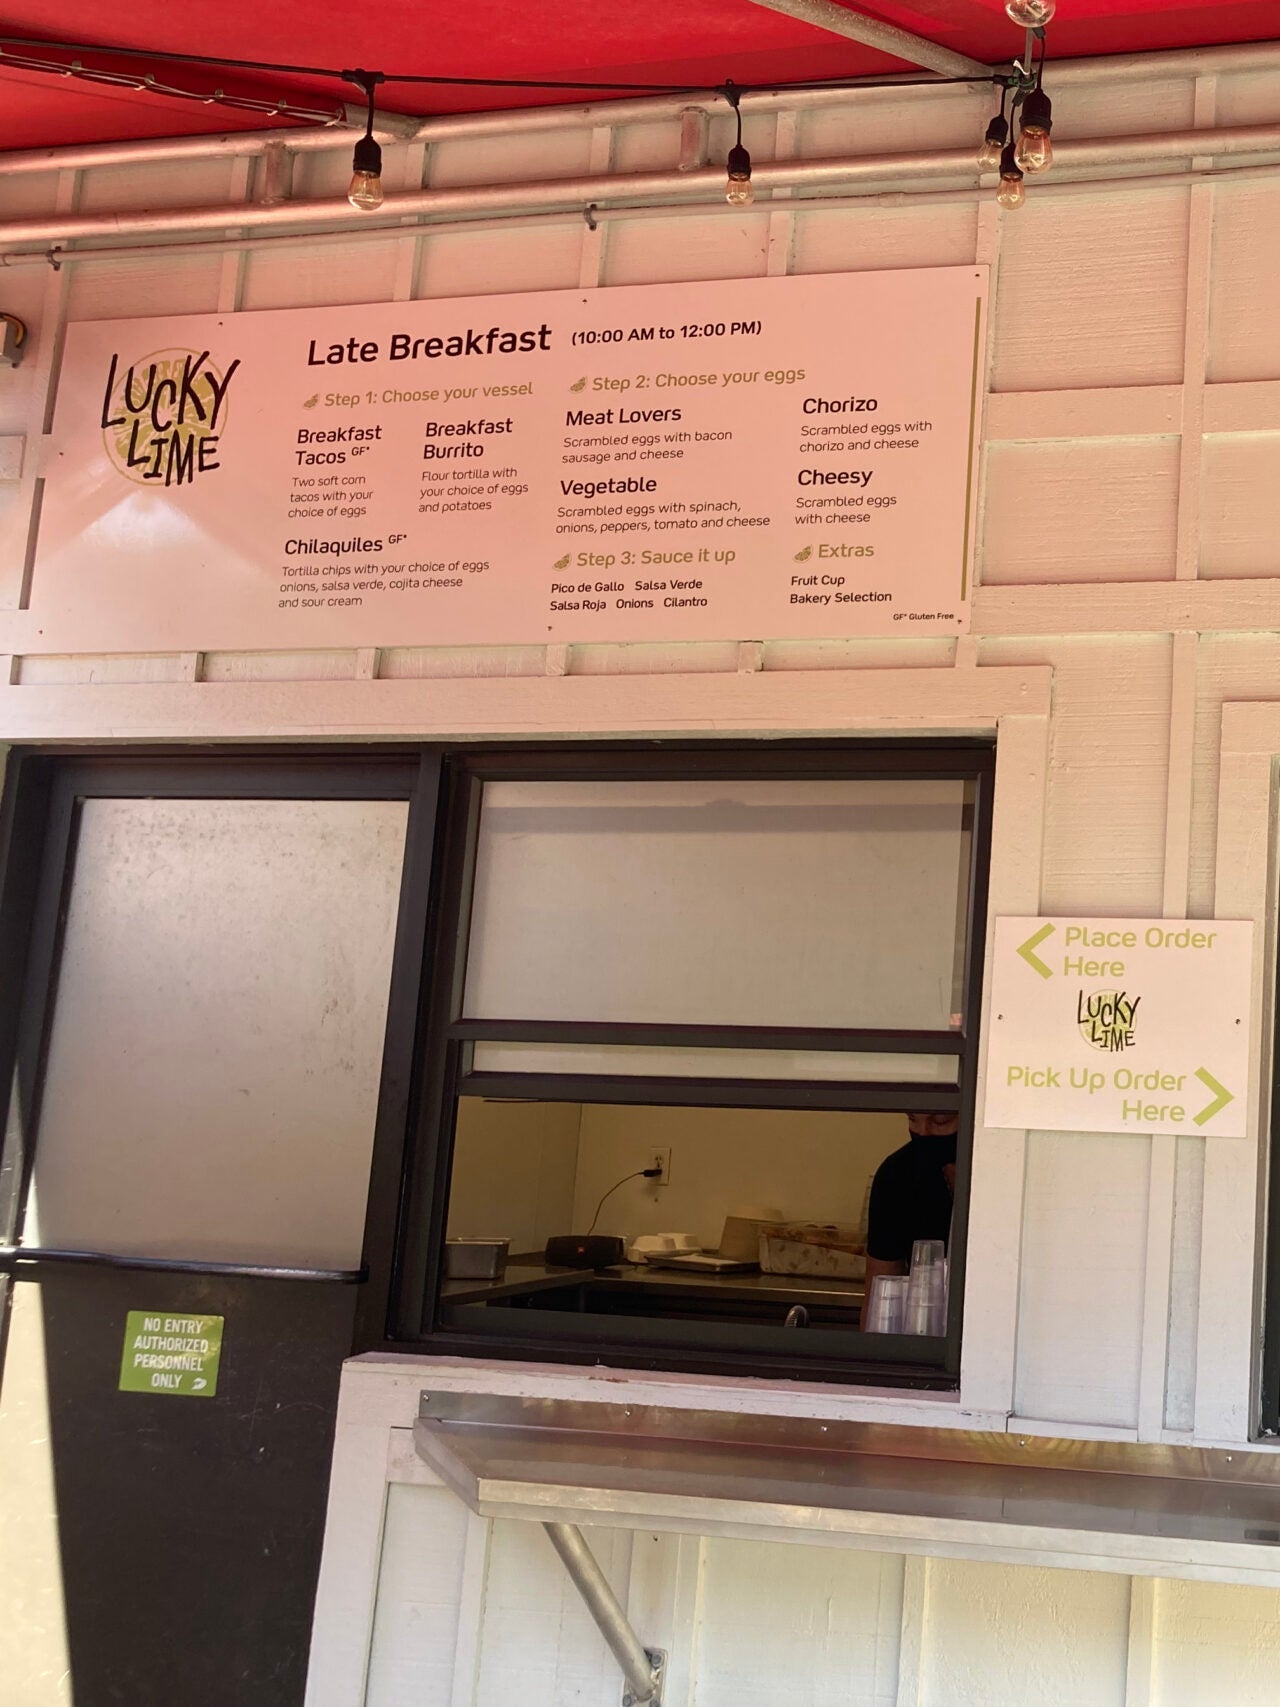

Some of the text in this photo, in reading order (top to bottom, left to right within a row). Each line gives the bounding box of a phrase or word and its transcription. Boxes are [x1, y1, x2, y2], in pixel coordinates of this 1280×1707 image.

[307, 320, 762, 366] Late Breakfast (10:00 AM to 12:00 PM)
[101, 350, 241, 432] LUCKY
[592, 369, 806, 394] Step 2: Choose your eggs
[324, 381, 534, 409] Step 1: Choose your vessel
[802, 396, 878, 414] Chorizo
[566, 408, 682, 427] Meat Lovers
[297, 424, 383, 444] Breakfast
[425, 417, 514, 438] Breakfast
[126, 418, 220, 487] LIME
[295, 450, 346, 466] Tacos
[423, 442, 484, 460] Burrito
[292, 475, 366, 487] Two soft corn
[560, 476, 657, 499] Vegetable
[798, 469, 873, 488] Cheesy
[290, 490, 374, 503] tacos with your
[287, 505, 367, 519] choice of eggs
[284, 537, 383, 558] Chilaquiles
[818, 543, 875, 559] Extras
[576, 548, 736, 570] Step 3: Sauce it up
[551, 579, 703, 594] Pico de Gallo Salsa Verde
[791, 574, 845, 588] Fruit Cup
[550, 596, 708, 612] Salsa Roja Onions Cilantro
[790, 591, 892, 606] Bakery Selection
[908, 612, 936, 621] Gluten
[936, 612, 955, 620] Free
[1065, 926, 1217, 949] Place Order
[1063, 956, 1125, 977] Here
[1077, 990, 1141, 1028] LUCKY
[1091, 1020, 1136, 1052] LIME
[1007, 1066, 1187, 1094] Pick Up Order
[1122, 1100, 1186, 1122] Here
[144, 1317, 204, 1334] NO ENTRY
[133, 1335, 208, 1353] AUTHORIZED
[133, 1353, 204, 1371] PERSONNEL
[151, 1373, 183, 1388] ONLY
